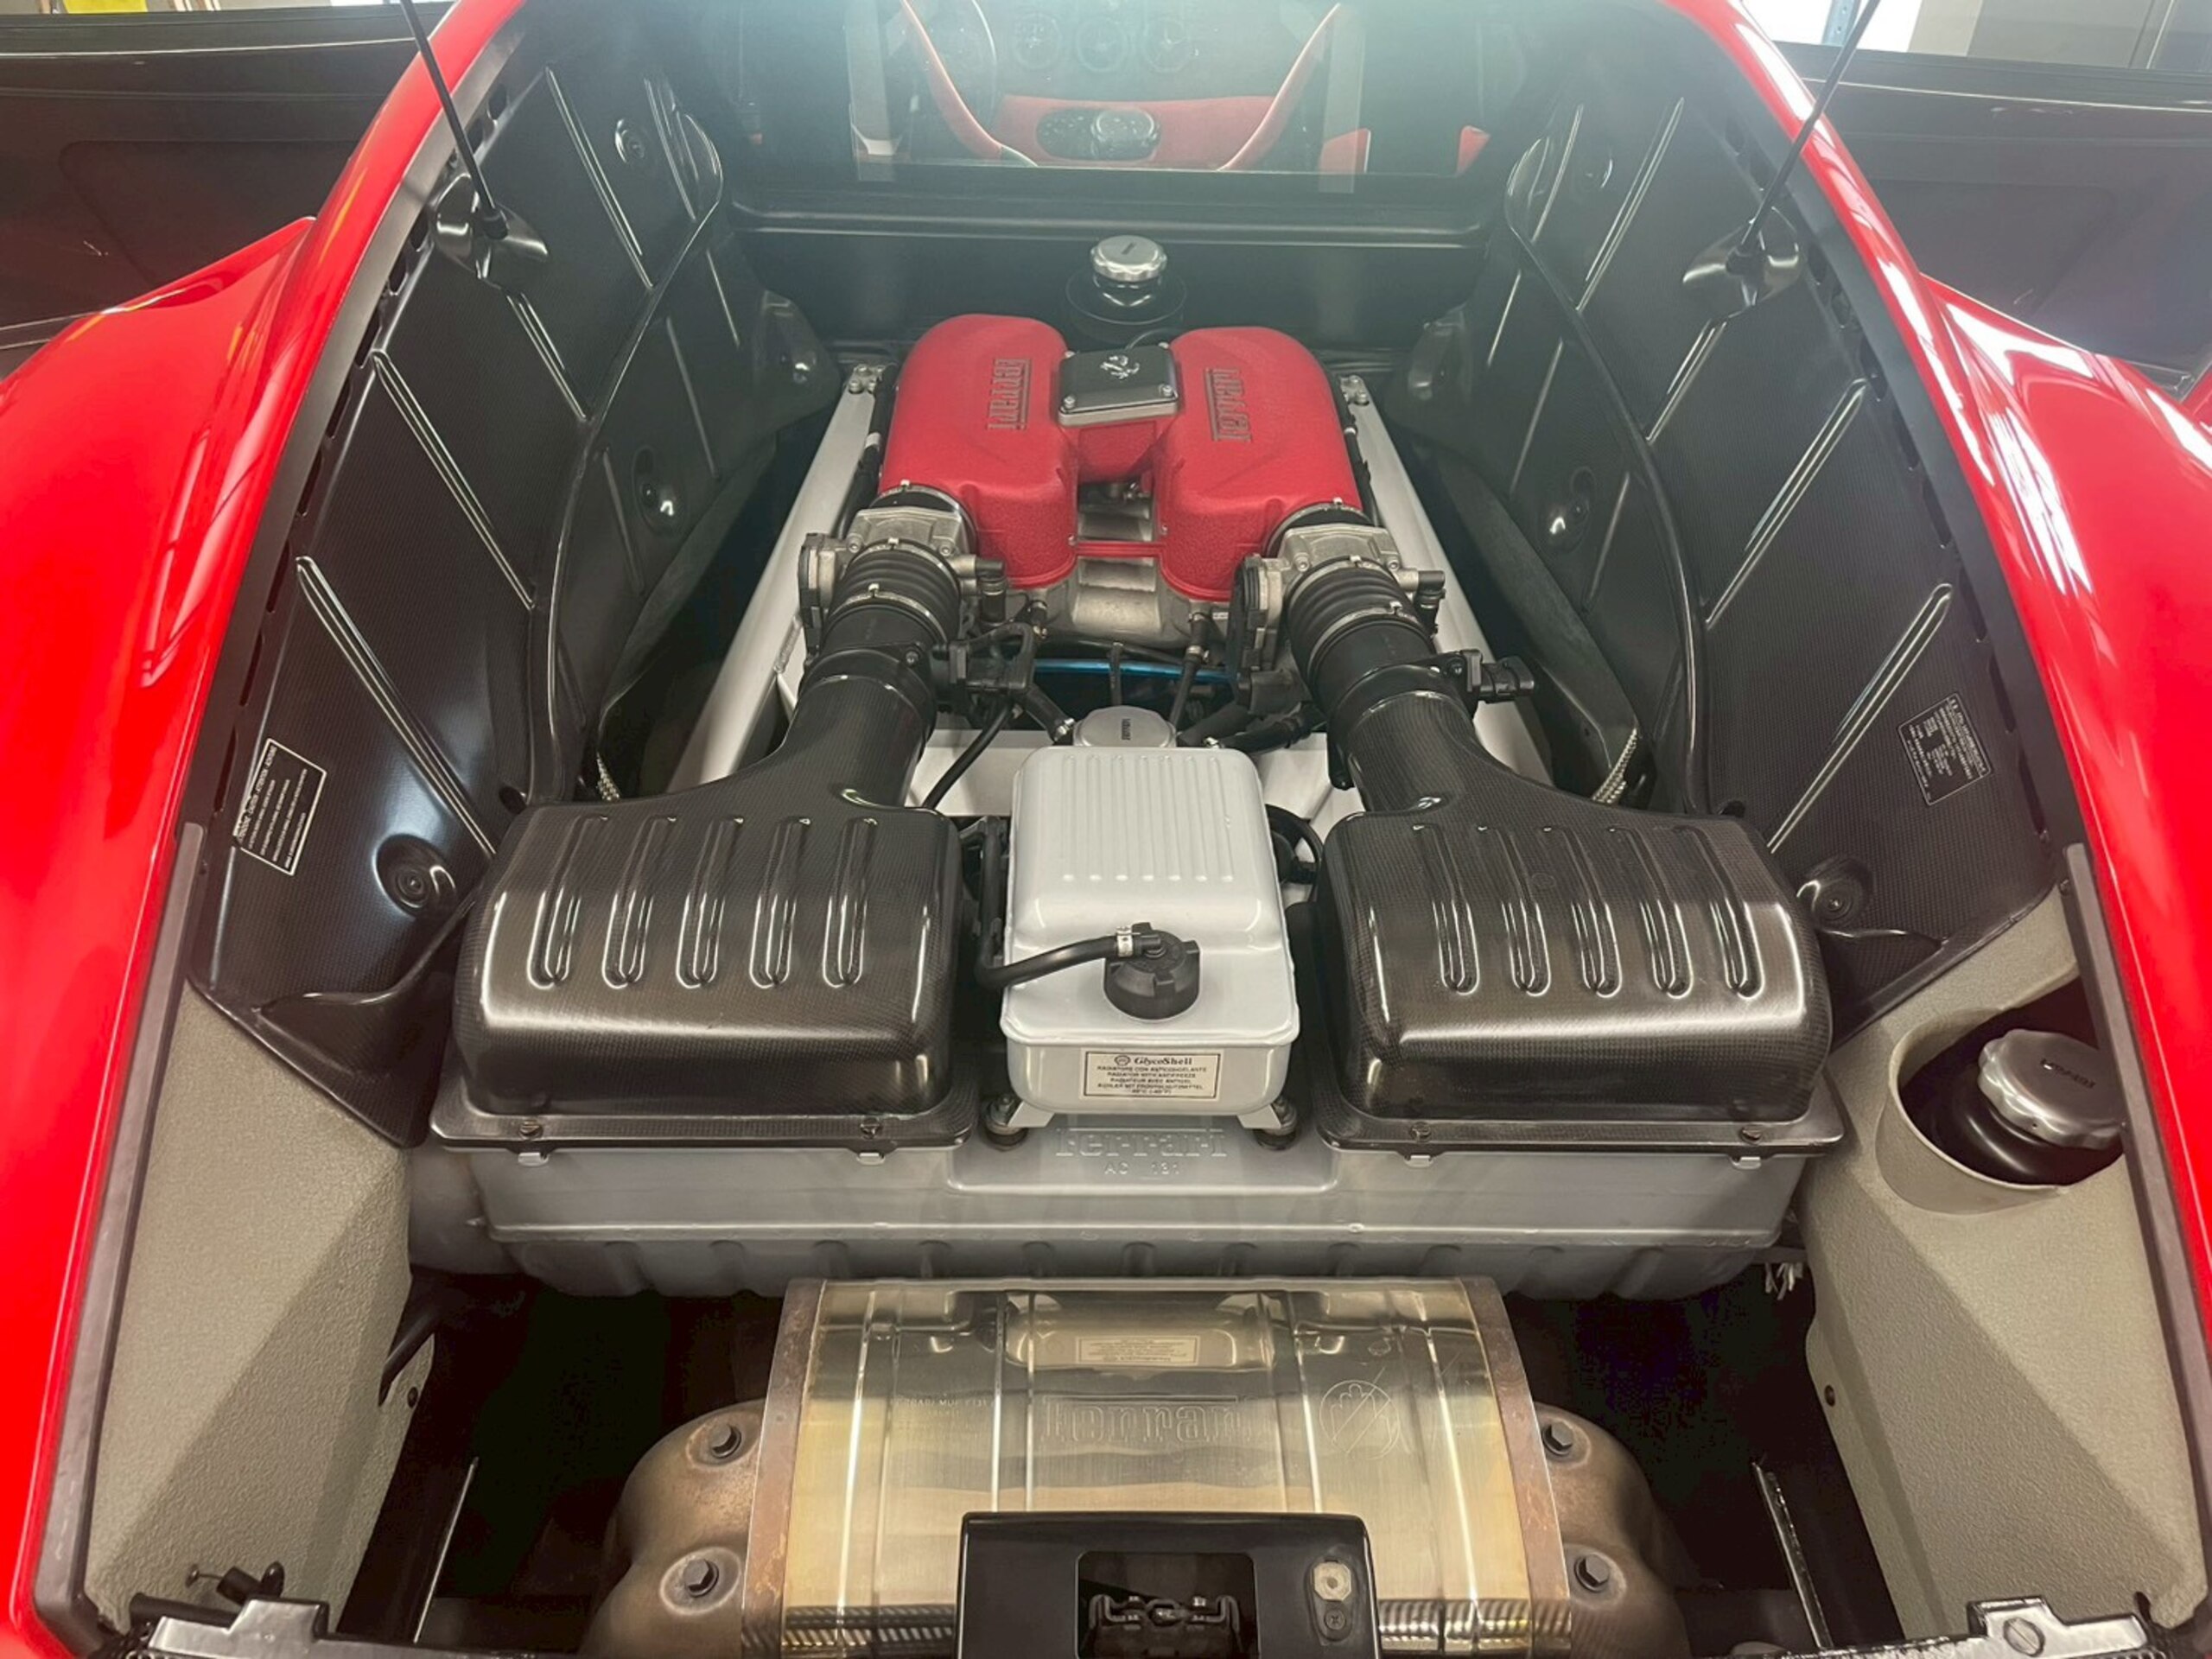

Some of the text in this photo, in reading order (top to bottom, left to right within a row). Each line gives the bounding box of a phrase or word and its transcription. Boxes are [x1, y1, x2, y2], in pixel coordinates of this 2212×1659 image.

[986, 358, 1032, 430] Ferrari
[1205, 367, 1251, 442] Ferrari
[1134, 1057, 1192, 1066] GlycoShell
[1055, 1128, 1227, 1157] Ferrari
